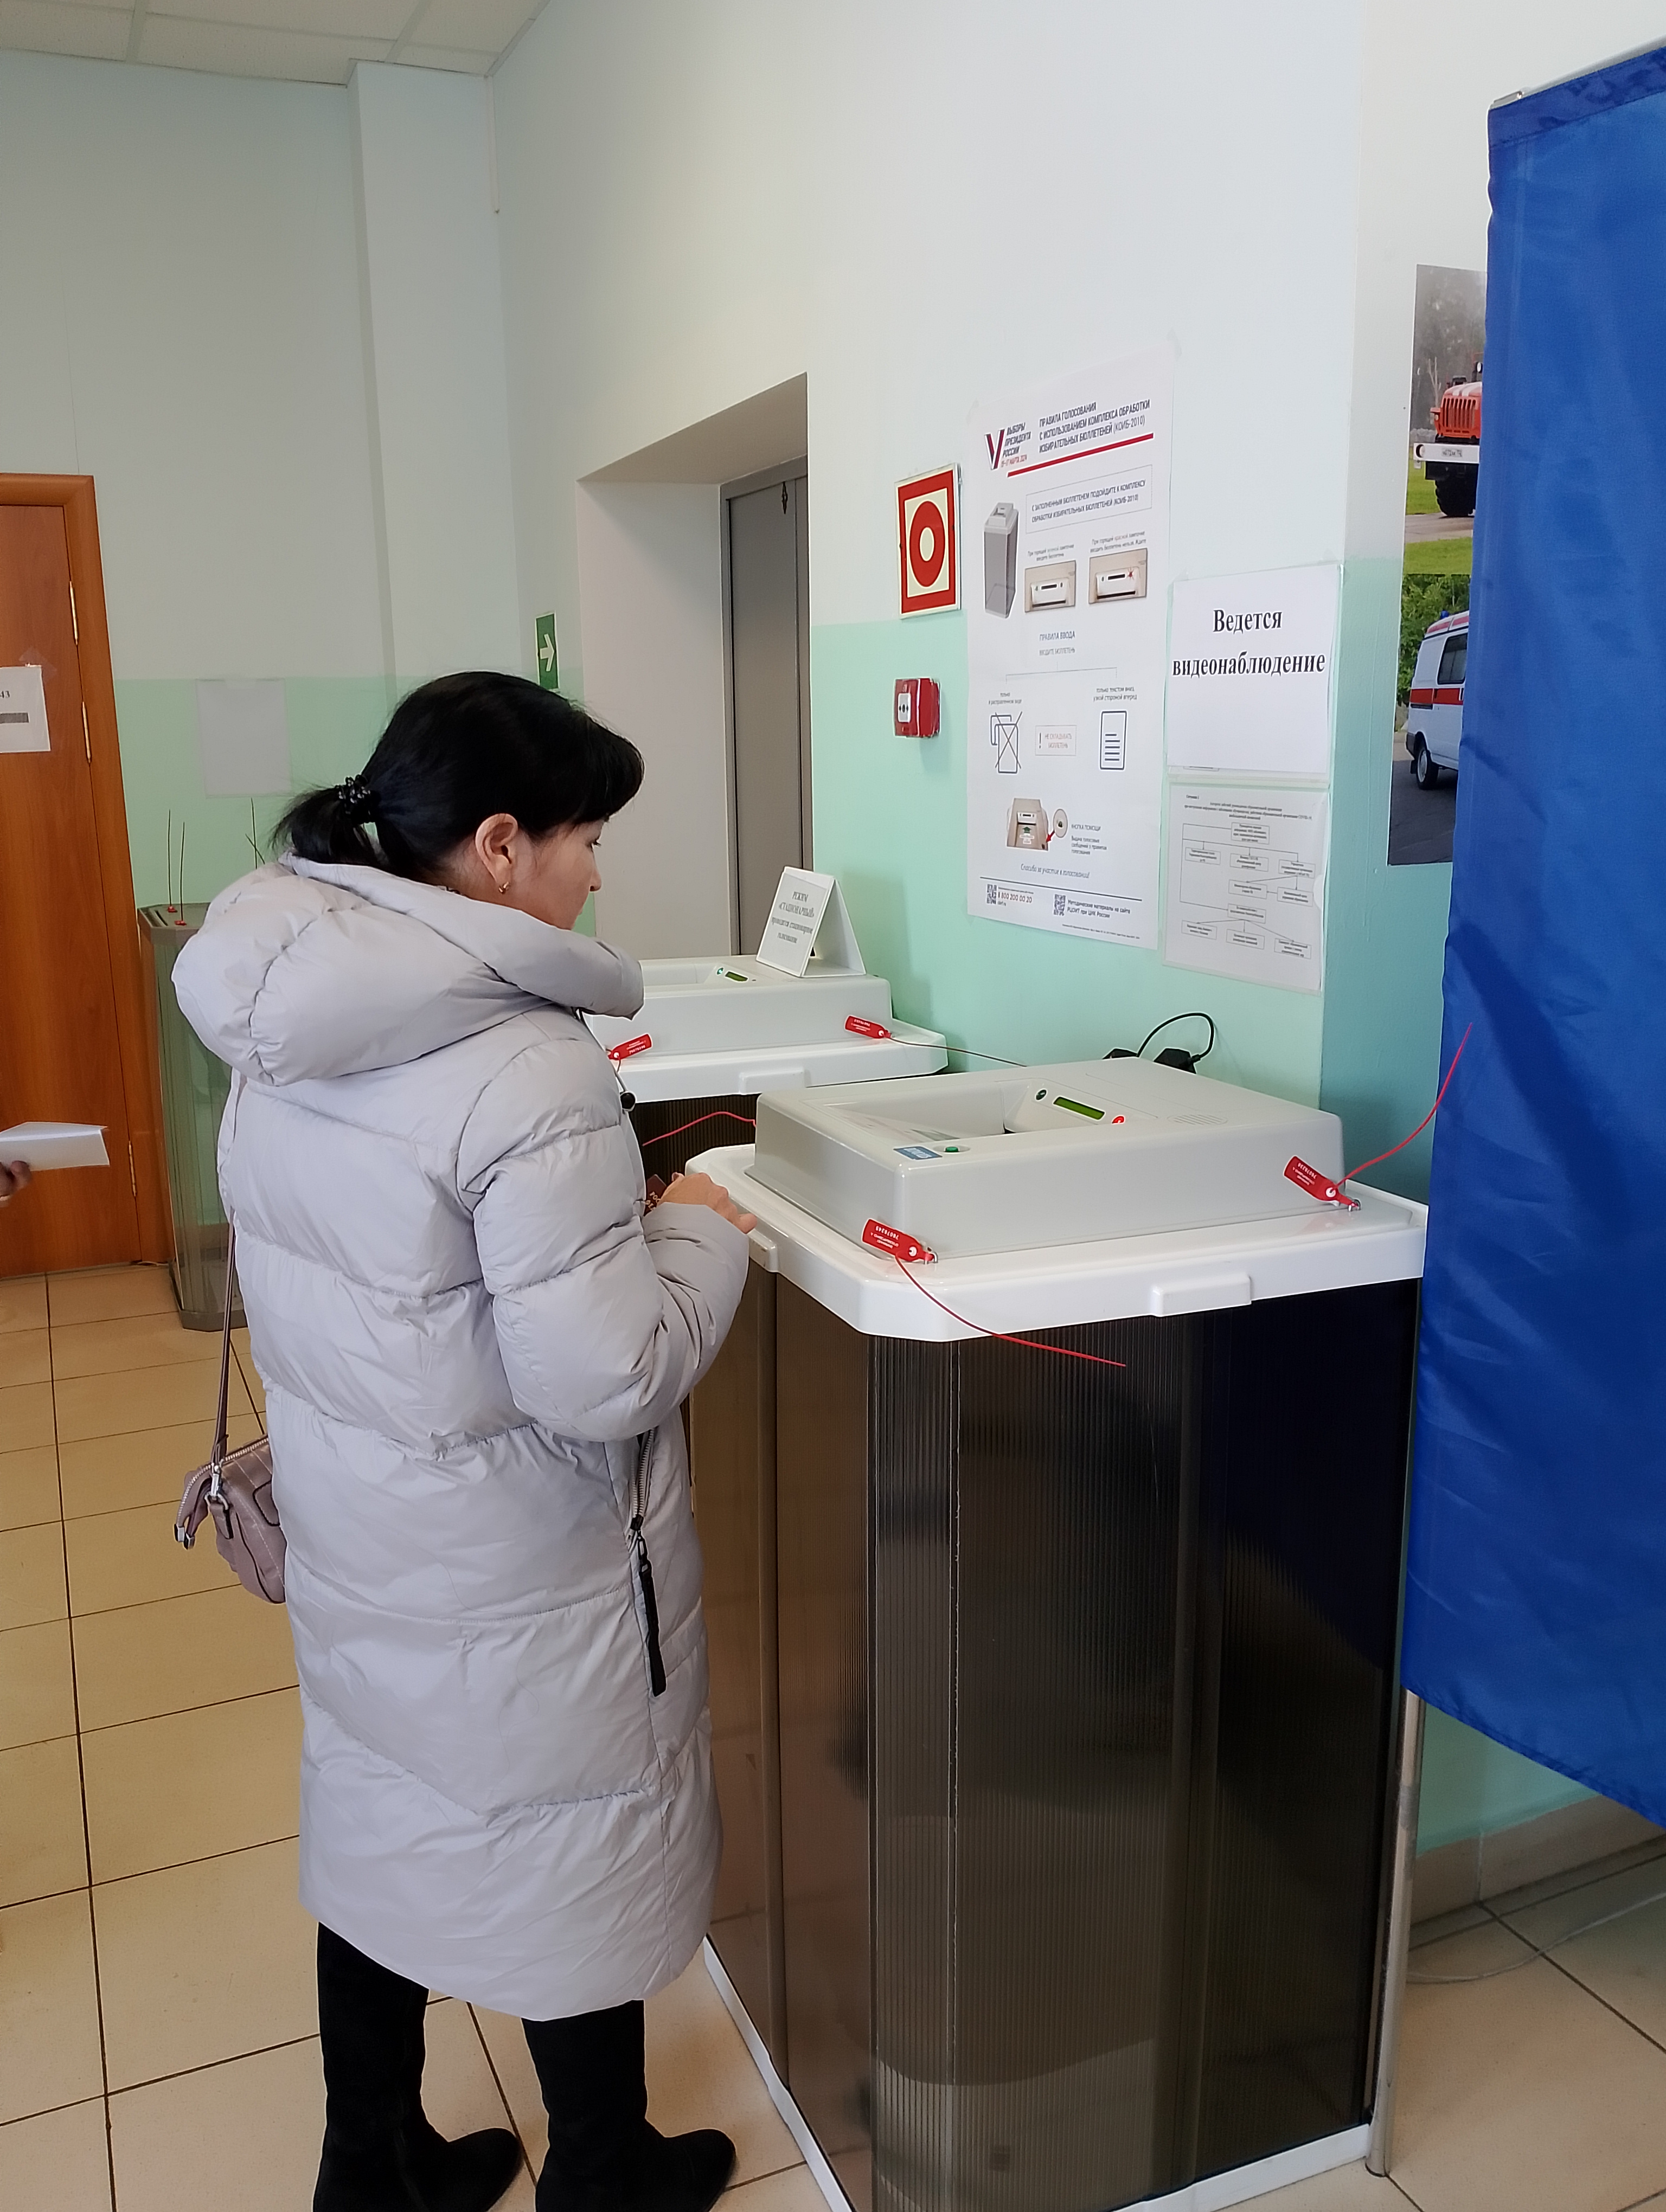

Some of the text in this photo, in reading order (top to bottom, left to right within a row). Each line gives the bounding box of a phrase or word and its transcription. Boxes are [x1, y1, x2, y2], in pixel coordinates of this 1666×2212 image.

[1039, 399, 1150, 440] С ИСПОЛЬЗОВАНИЕМ КОМПЛЕКСА ОБРАБОТКИ
[1040, 402, 1096, 427] ПРАВИЛА ГОЛОСОВАНИЯ
[1039, 415, 1145, 453] ИЗБИРАТЕЛЬНЫХ БЮЛЛЕТЕНЕЙ (КОИБ-2010)
[1212, 609, 1283, 635] Ведется
[1040, 631, 1075, 641] ПРАВИЛА ВВОДА
[1172, 651, 1325, 679] видеонаблюдение
